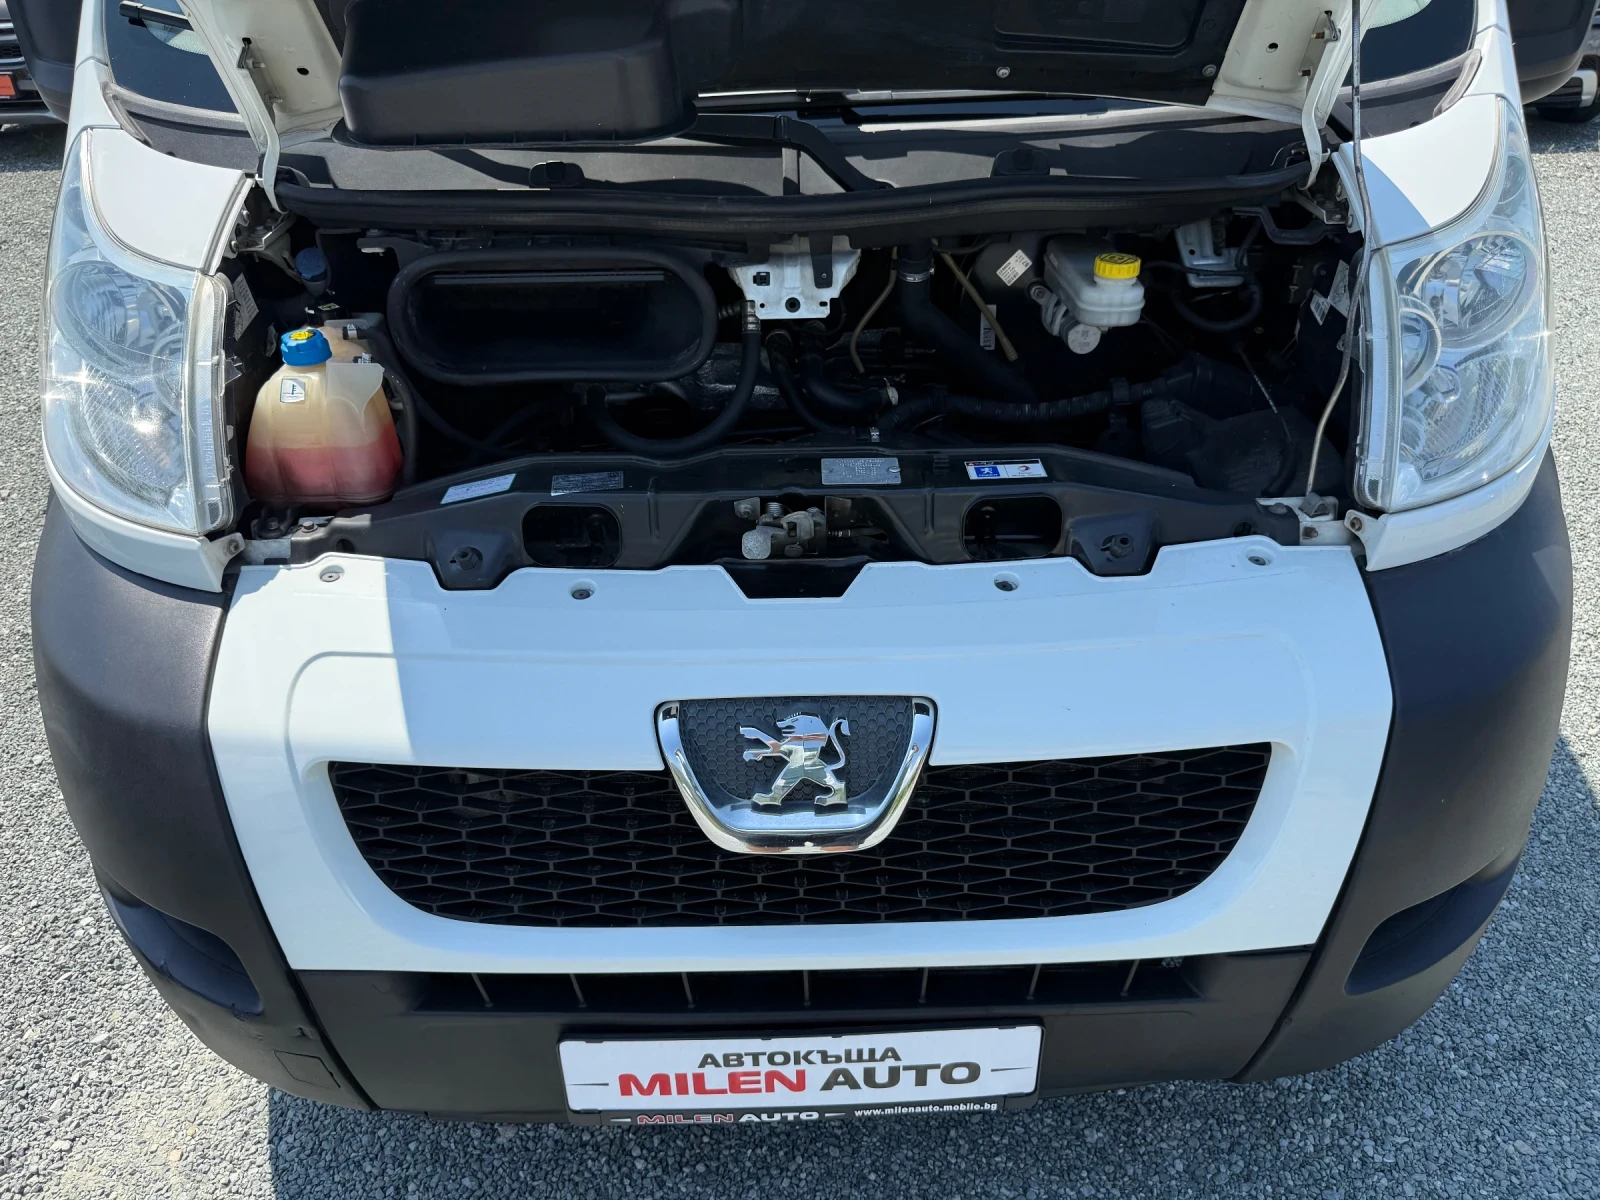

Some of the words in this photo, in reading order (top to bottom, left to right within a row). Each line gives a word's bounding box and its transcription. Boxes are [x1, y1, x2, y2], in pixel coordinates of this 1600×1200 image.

[697, 1046, 903, 1069] АВТОКЪША
[618, 1068, 806, 1097] MILEN
[819, 1061, 982, 1092] AUTO
[636, 1113, 734, 1125] MILEN
[738, 1111, 820, 1123] AUTO
[854, 1102, 998, 1118] www.milenauto.mobile.bg
